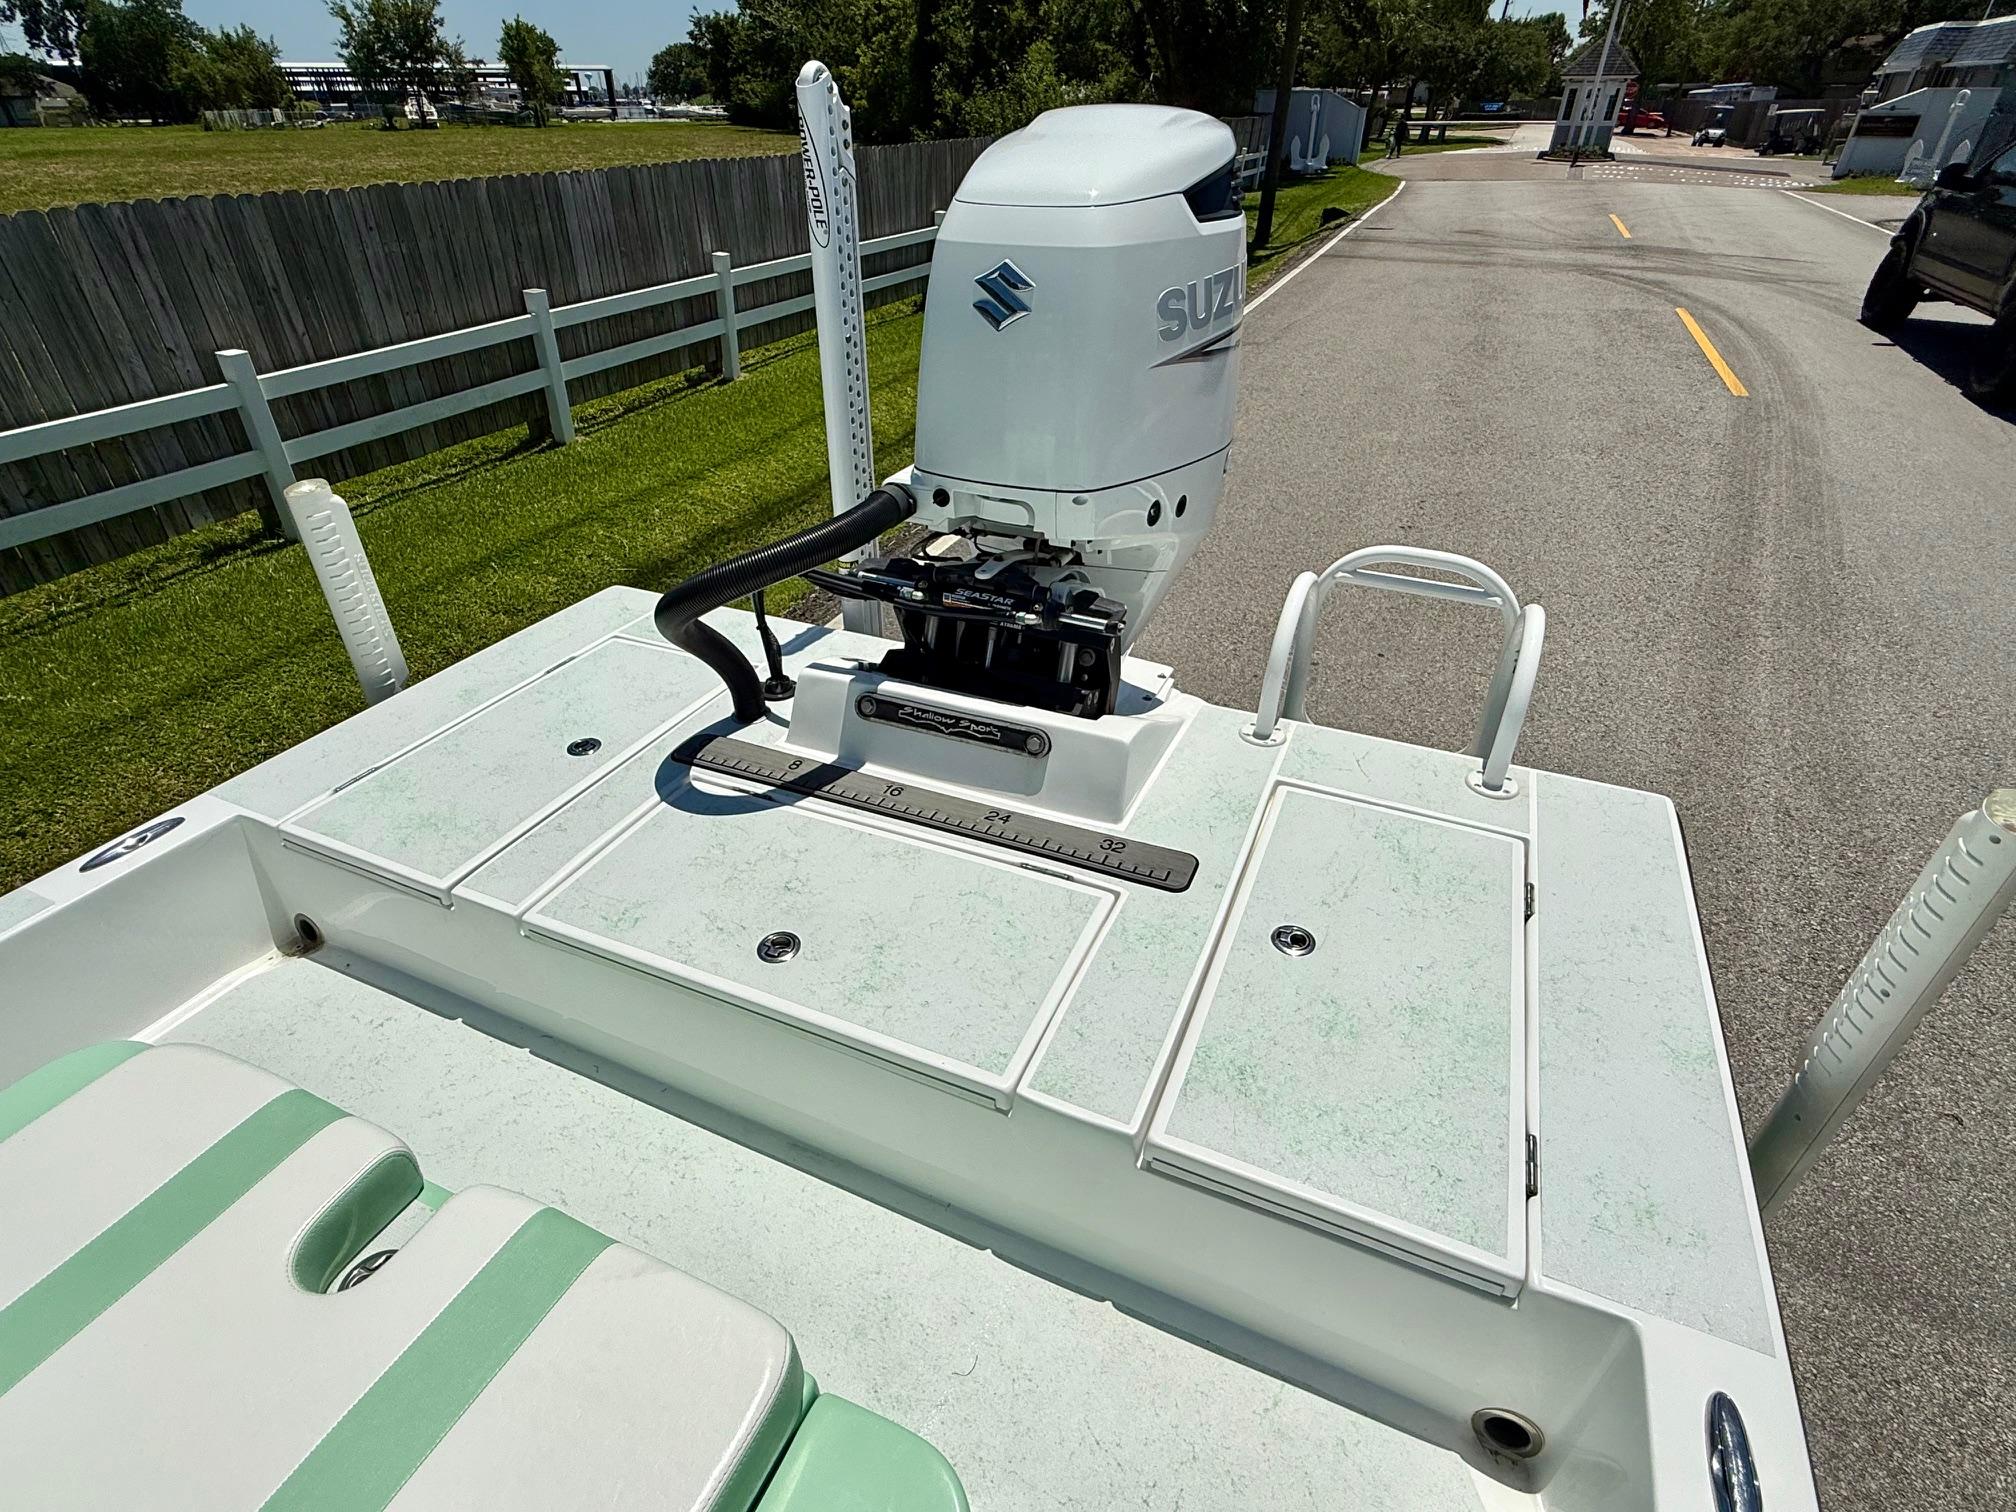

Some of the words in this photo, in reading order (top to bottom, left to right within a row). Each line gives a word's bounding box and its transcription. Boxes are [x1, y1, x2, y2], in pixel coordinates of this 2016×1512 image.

[898, 706, 956, 724] Shallow
[788, 759, 803, 770] 8
[882, 784, 904, 798] 16
[983, 810, 1012, 825] 24
[1099, 838, 1126, 853] 32
